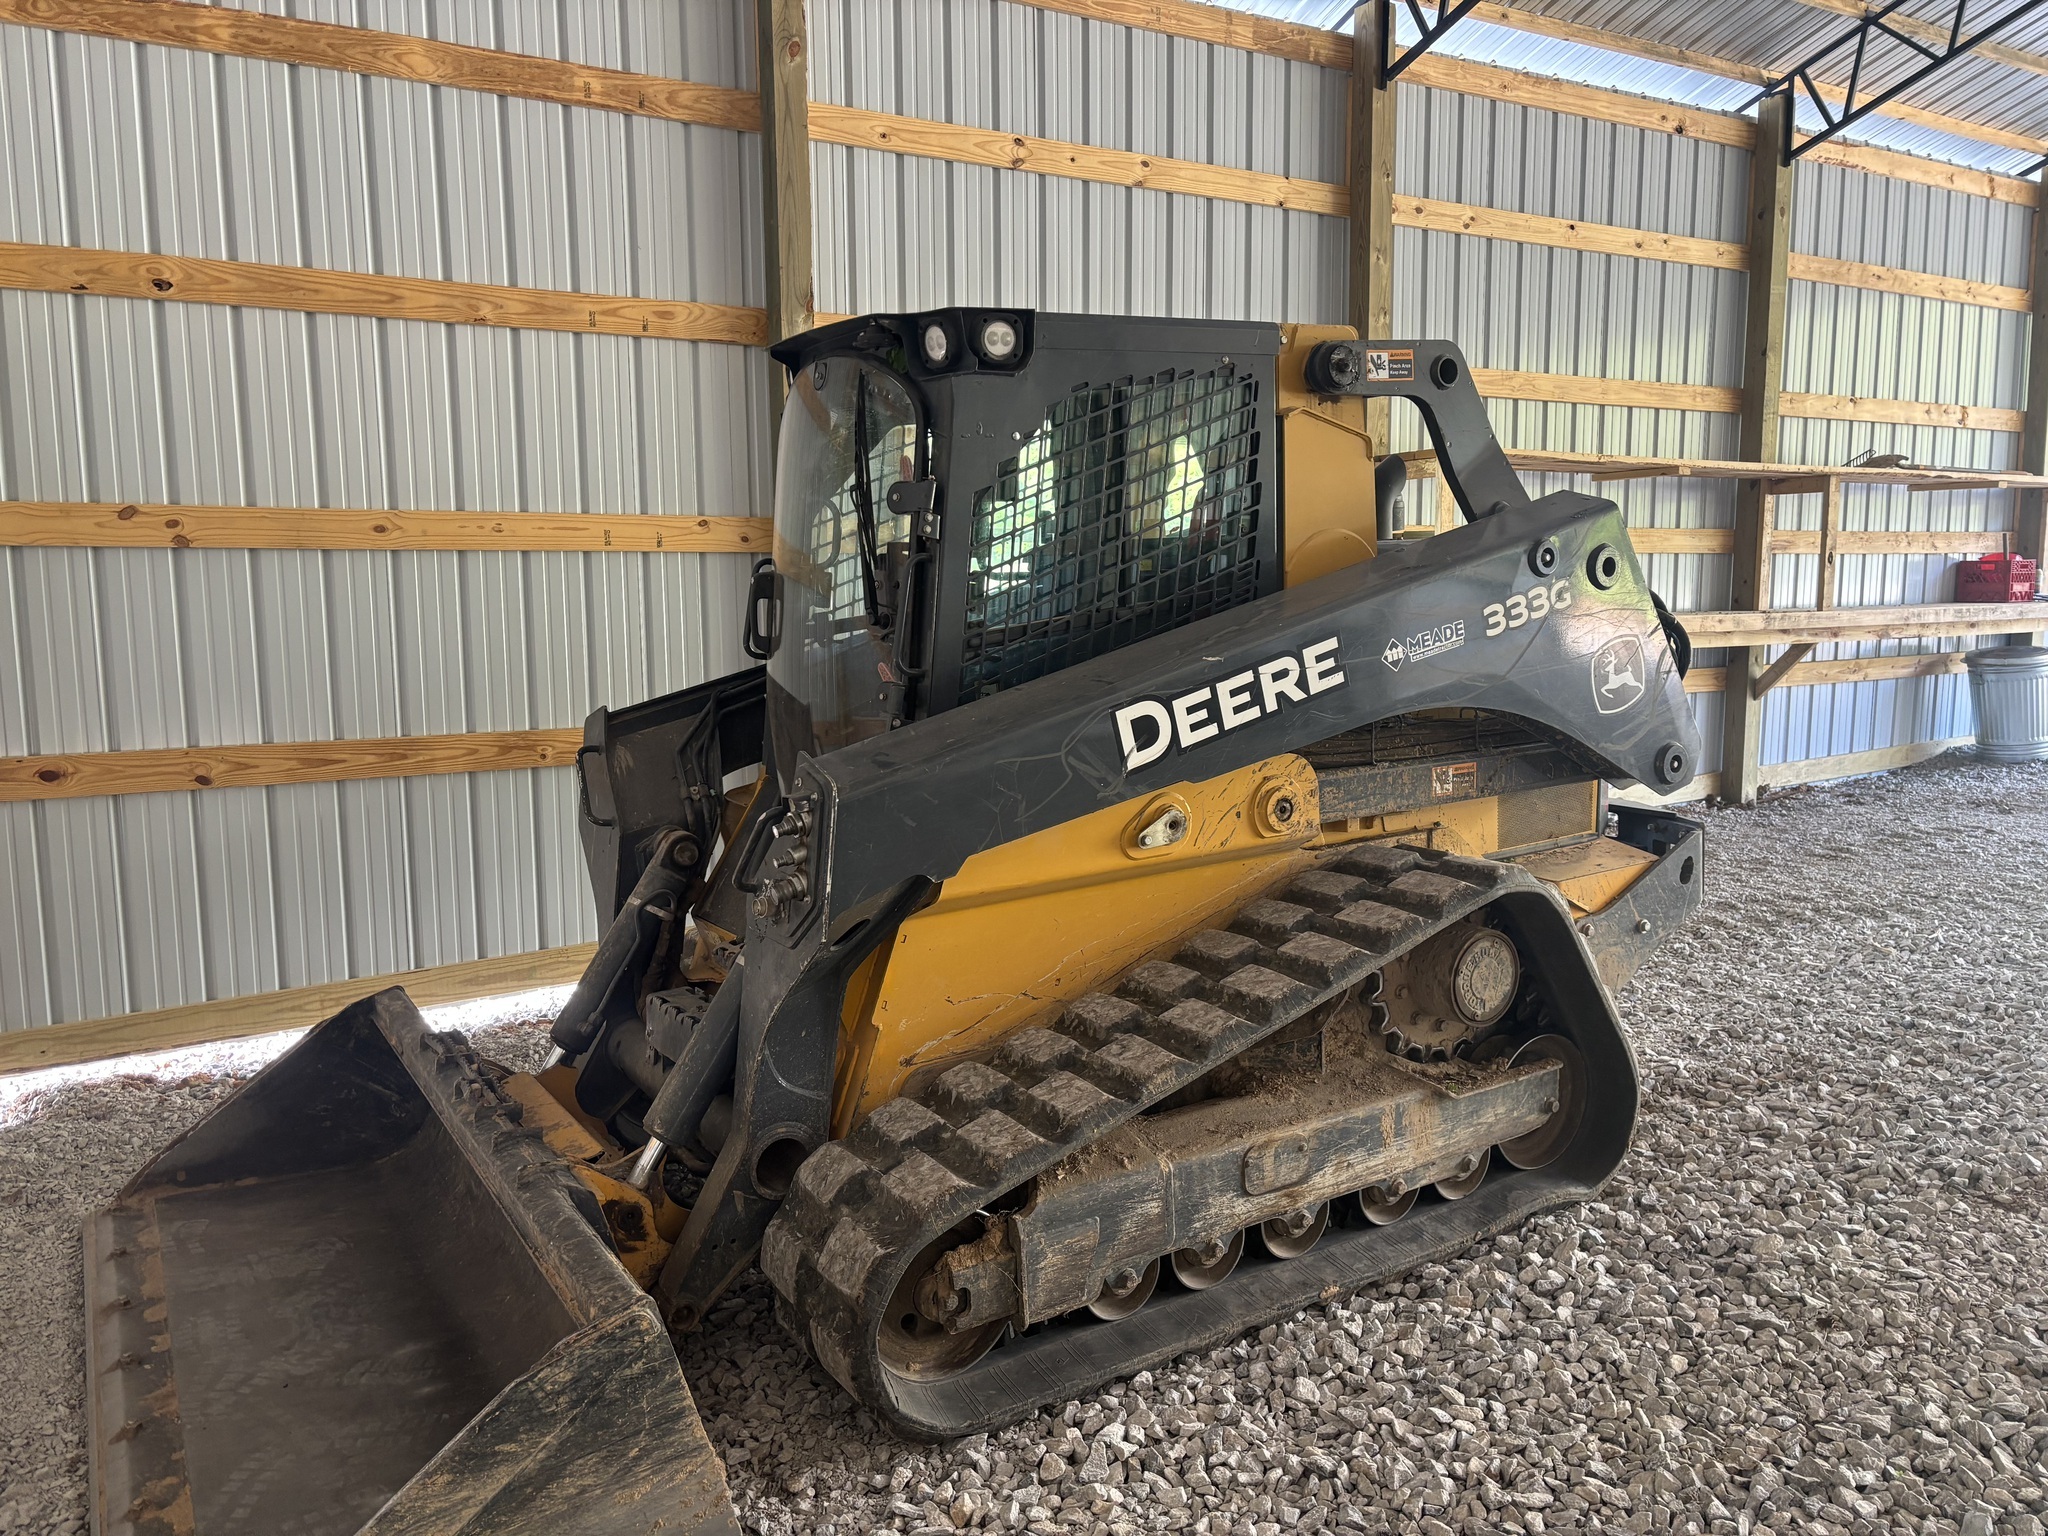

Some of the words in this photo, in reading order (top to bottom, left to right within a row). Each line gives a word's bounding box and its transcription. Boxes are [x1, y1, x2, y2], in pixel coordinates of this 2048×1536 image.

[1407, 620, 1465, 653] MEADE
[1483, 580, 1572, 637] 333G
[1115, 636, 1345, 772] DEERE
